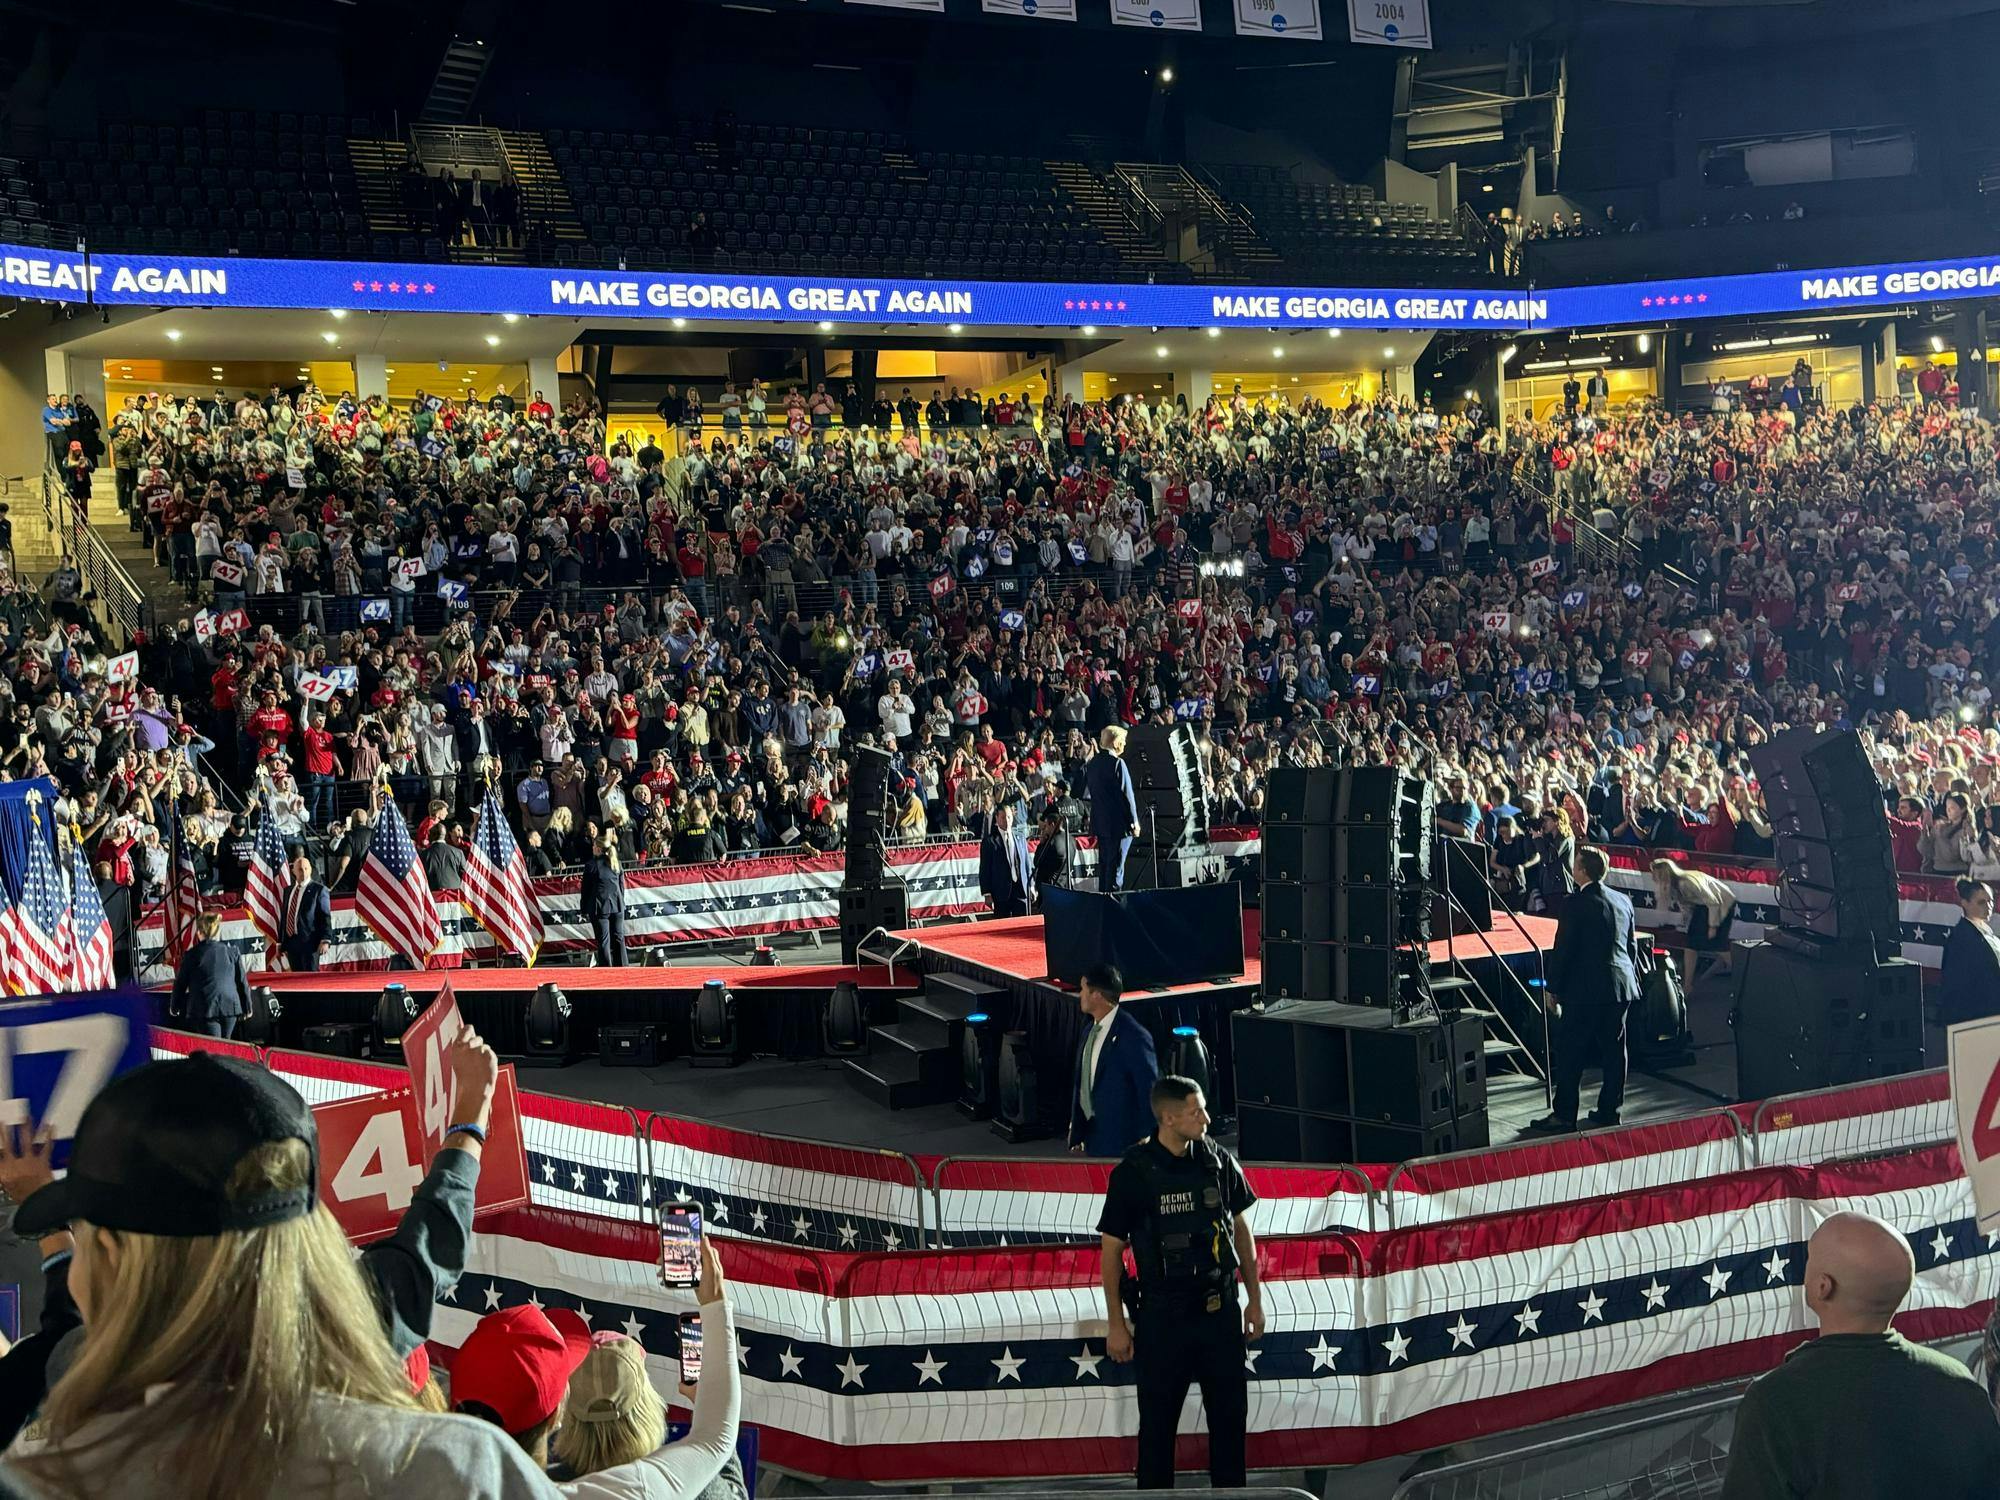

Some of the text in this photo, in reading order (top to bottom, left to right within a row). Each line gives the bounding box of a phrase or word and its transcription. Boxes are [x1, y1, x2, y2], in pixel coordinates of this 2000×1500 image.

[1375, 3, 1405, 20] 2004
[0, 256, 227, 295] REAT AGAIN
[1802, 264, 2000, 300] MAKE GEORGIA
[550, 280, 972, 314] MAKE GEORGIA GREAT AGAIN
[1212, 296, 1547, 320] MAKE GEORGIA GREAT AGAIN
[774, 438, 793, 451] 47
[1020, 441, 1034, 451] 47
[560, 452, 576, 465] 47
[1699, 482, 1717, 493] 47
[1215, 491, 1226, 503] 47
[1841, 511, 1859, 524] 47
[977, 530, 995, 541] 47
[1975, 522, 1992, 534] 47
[216, 565, 240, 580] 47
[401, 560, 420, 574] 47
[1533, 558, 1549, 572] 47
[440, 582, 465, 599] 47
[933, 577, 949, 594] 47
[1001, 582, 1014, 591] 109
[1623, 583, 1642, 599] 47
[1839, 585, 1859, 599] 47
[452, 601, 470, 609] 108
[1563, 591, 1583, 606] 47
[364, 601, 387, 617] 47
[1181, 600, 1200, 615] 47
[221, 610, 243, 631] 47
[579, 614, 597, 627] 47
[1002, 612, 1024, 628] 47
[1294, 609, 1314, 623] 47
[1486, 615, 1507, 628] 47
[113, 656, 135, 675] 47
[856, 655, 876, 672] 47
[889, 653, 908, 665] 47
[1627, 651, 1649, 665] 47
[327, 668, 353, 688] 47
[530, 675, 549, 683] USA
[1354, 676, 1377, 691] 47
[1533, 671, 1552, 687] 47
[302, 679, 331, 696] 47
[1430, 680, 1449, 696] 47
[961, 696, 980, 715] 47
[1177, 701, 1199, 717] 47
[688, 828, 706, 836] POLICE
[1160, 1191, 1193, 1204] SECRET
[1160, 1202, 1195, 1215] SERVICE
